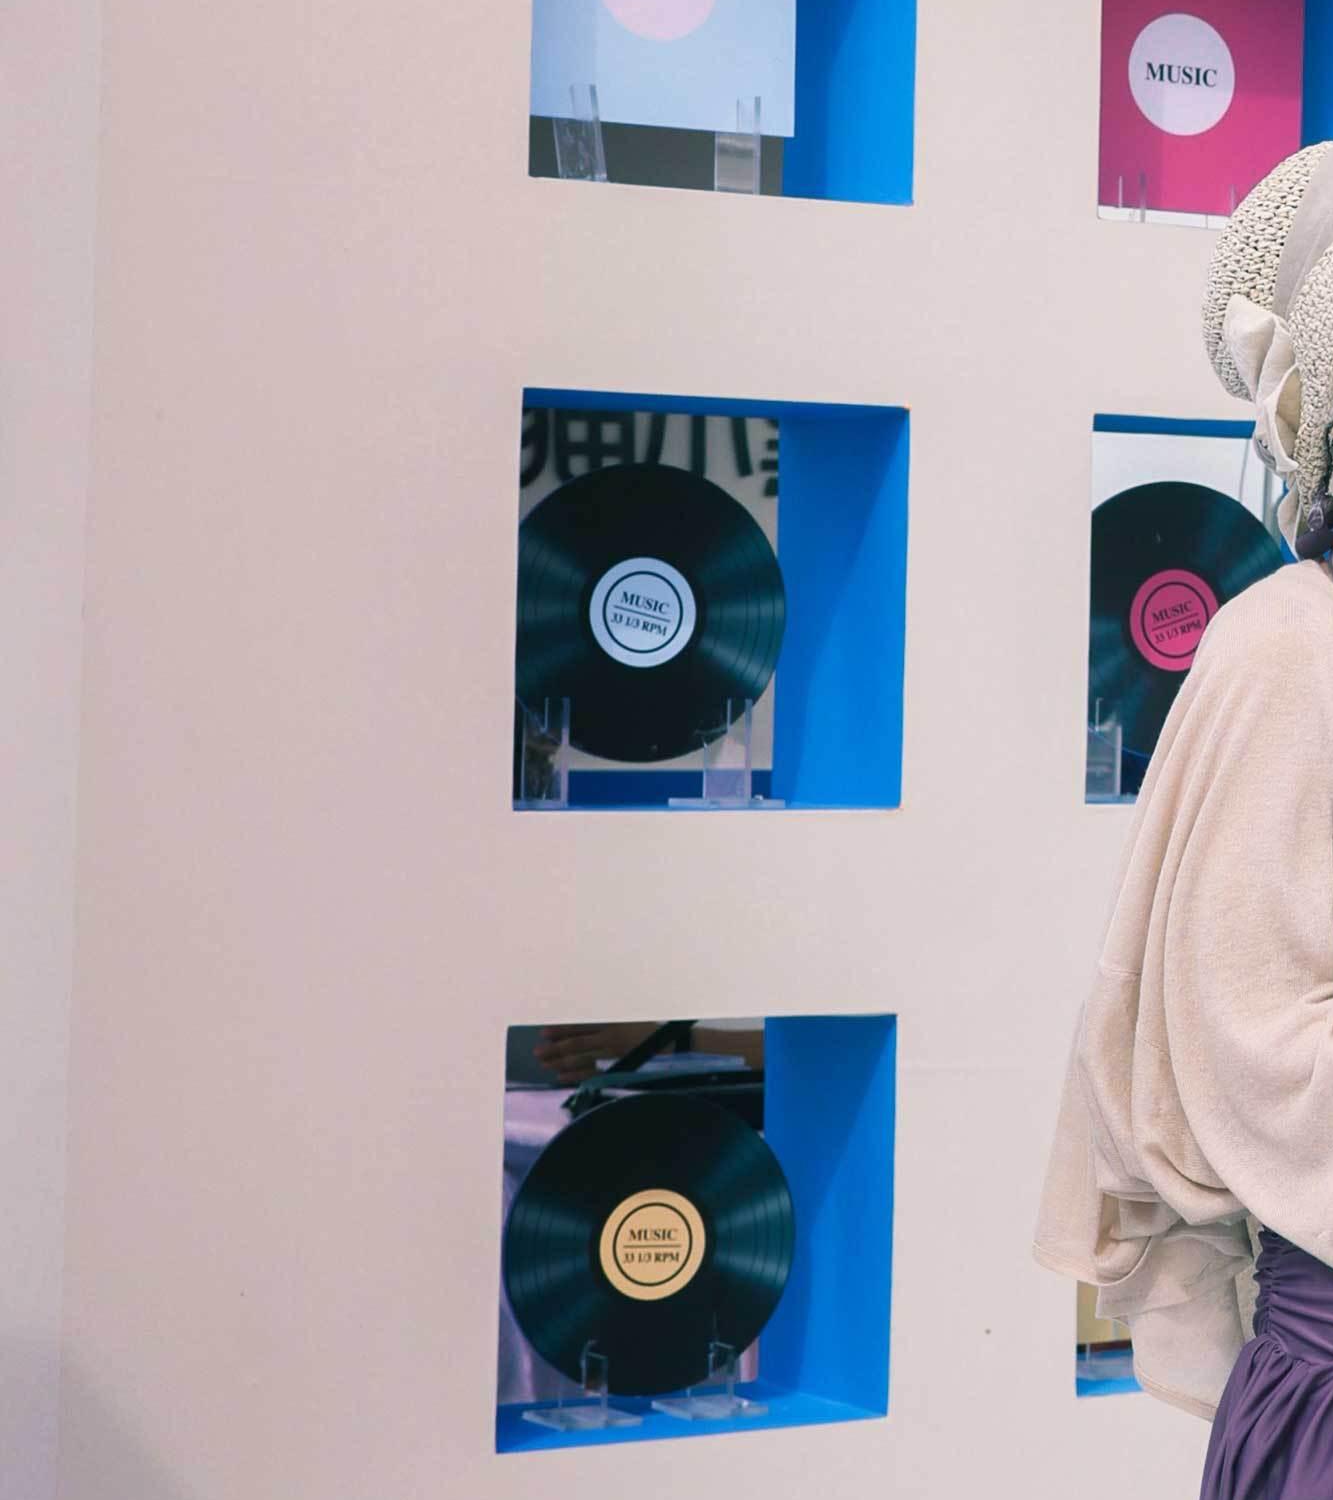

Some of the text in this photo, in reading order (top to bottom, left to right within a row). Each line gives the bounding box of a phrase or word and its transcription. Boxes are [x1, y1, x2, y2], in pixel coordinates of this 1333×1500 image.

[1145, 61, 1218, 89] MUSIC
[620, 591, 671, 615] MUSIC
[1152, 600, 1193, 624] MUSIC
[641, 620, 667, 637] RPM
[629, 1228, 680, 1242] MUSIC
[653, 1251, 680, 1263] RPM
